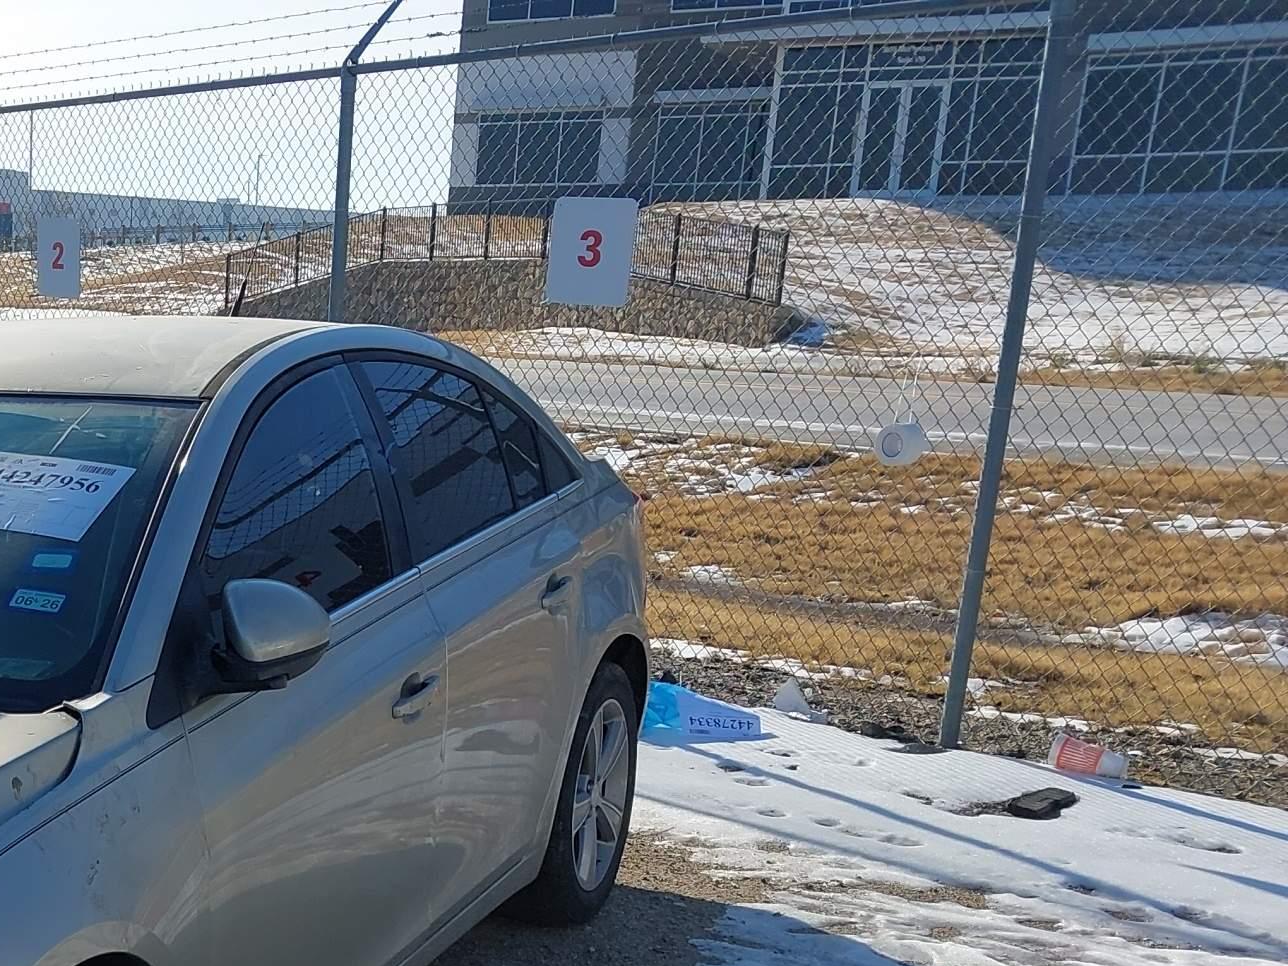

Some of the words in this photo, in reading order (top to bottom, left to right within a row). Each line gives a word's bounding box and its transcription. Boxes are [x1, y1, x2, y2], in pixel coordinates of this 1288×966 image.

[52, 241, 65, 269] 2
[577, 229, 603, 268] 3
[15, 595, 33, 606] 06
[40, 598, 60, 610] 26
[689, 715, 754, 731] 44278334
